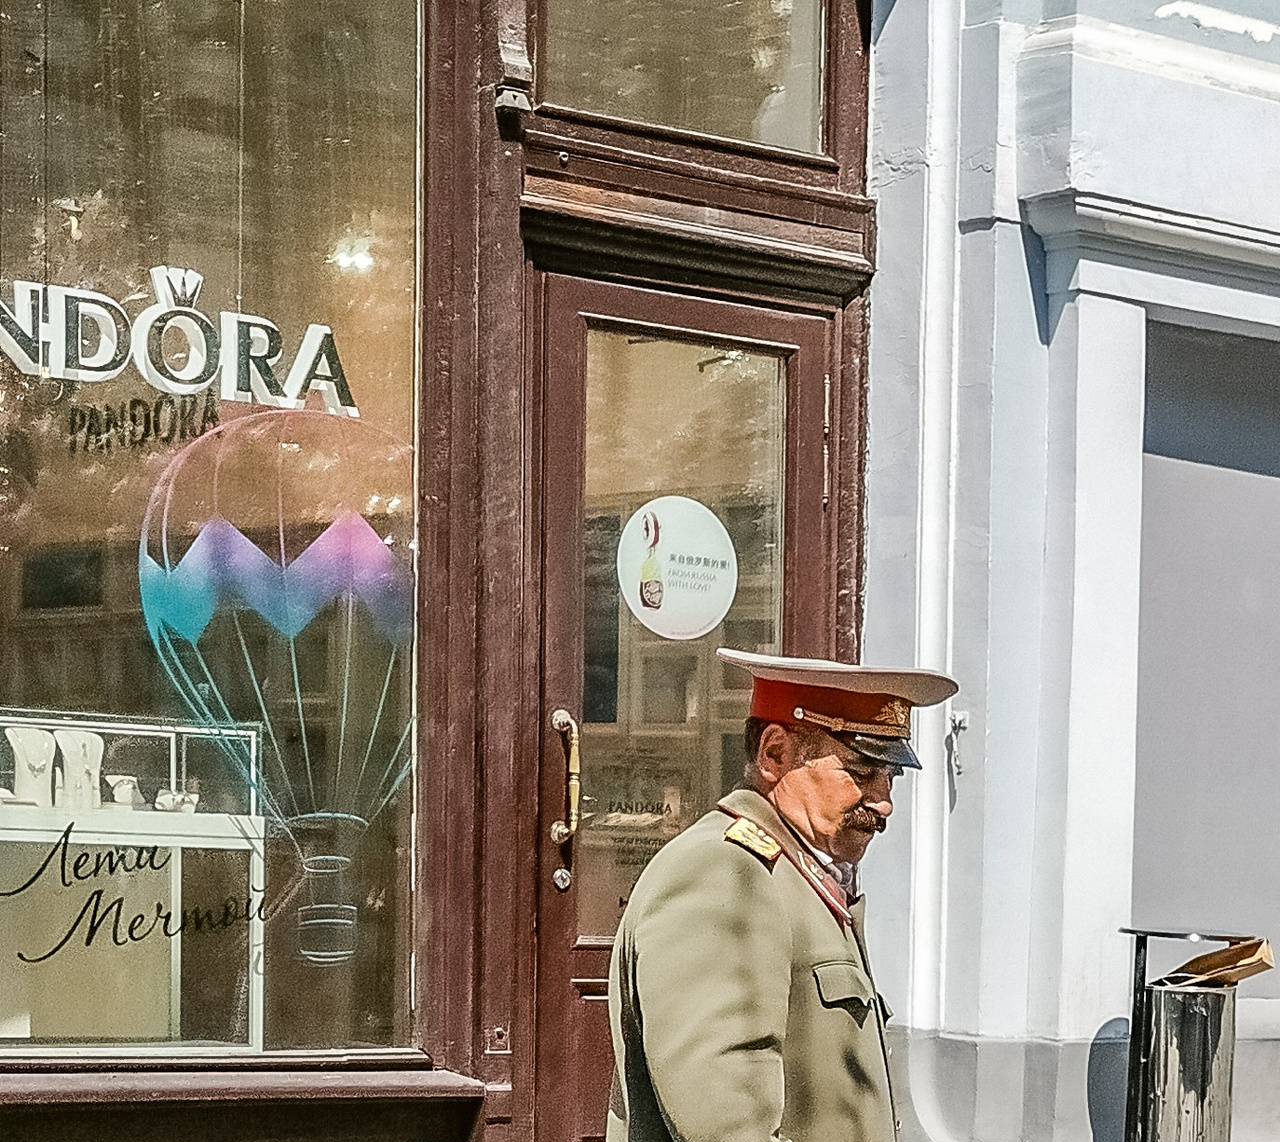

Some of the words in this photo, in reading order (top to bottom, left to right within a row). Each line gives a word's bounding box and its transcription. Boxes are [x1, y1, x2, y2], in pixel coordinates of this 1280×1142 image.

[608, 801, 672, 814] PANDORA
[0, 821, 171, 896] Лети
[17, 884, 268, 962] Мечтой
